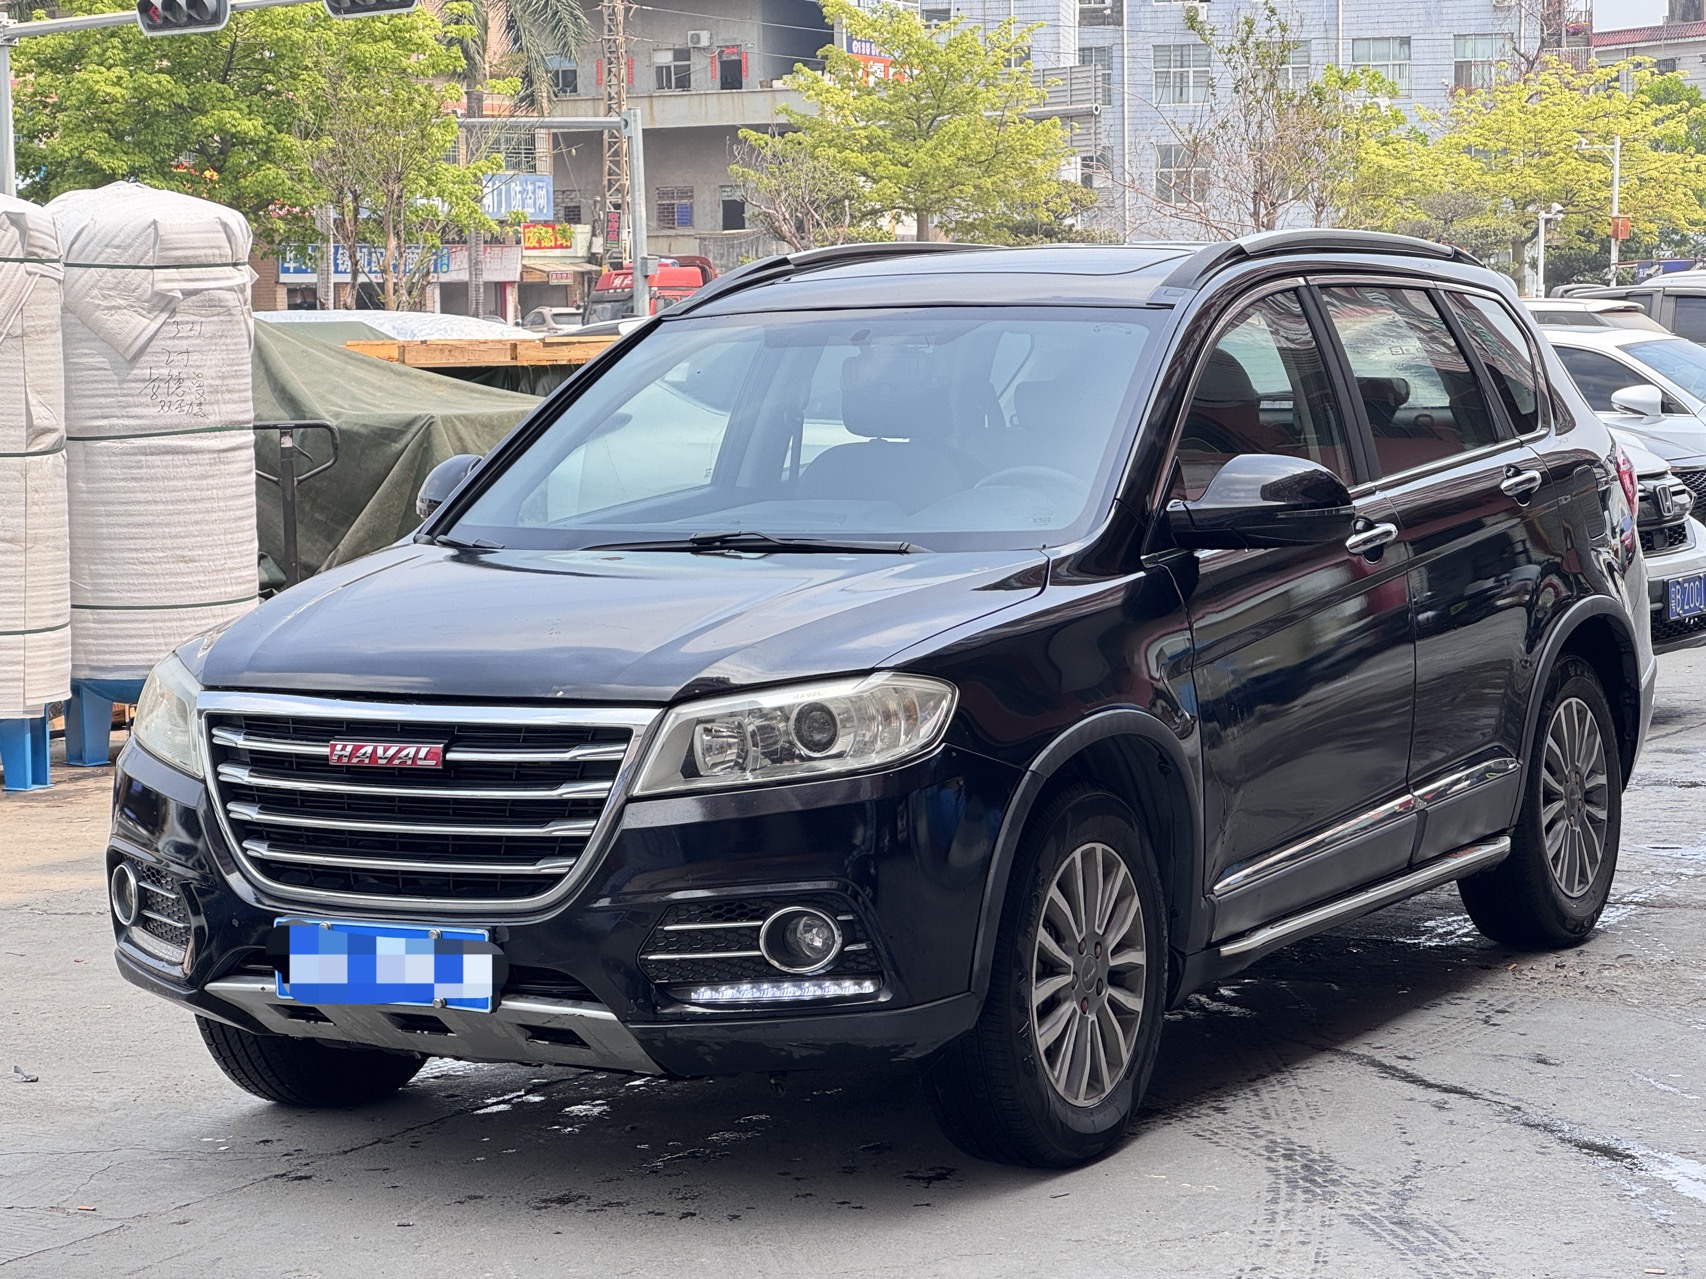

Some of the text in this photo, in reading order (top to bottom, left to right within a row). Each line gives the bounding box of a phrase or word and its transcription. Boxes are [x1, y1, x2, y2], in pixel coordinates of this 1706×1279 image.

[450, 247, 519, 271] 激镭雕
[331, 744, 437, 766] HAVAL
